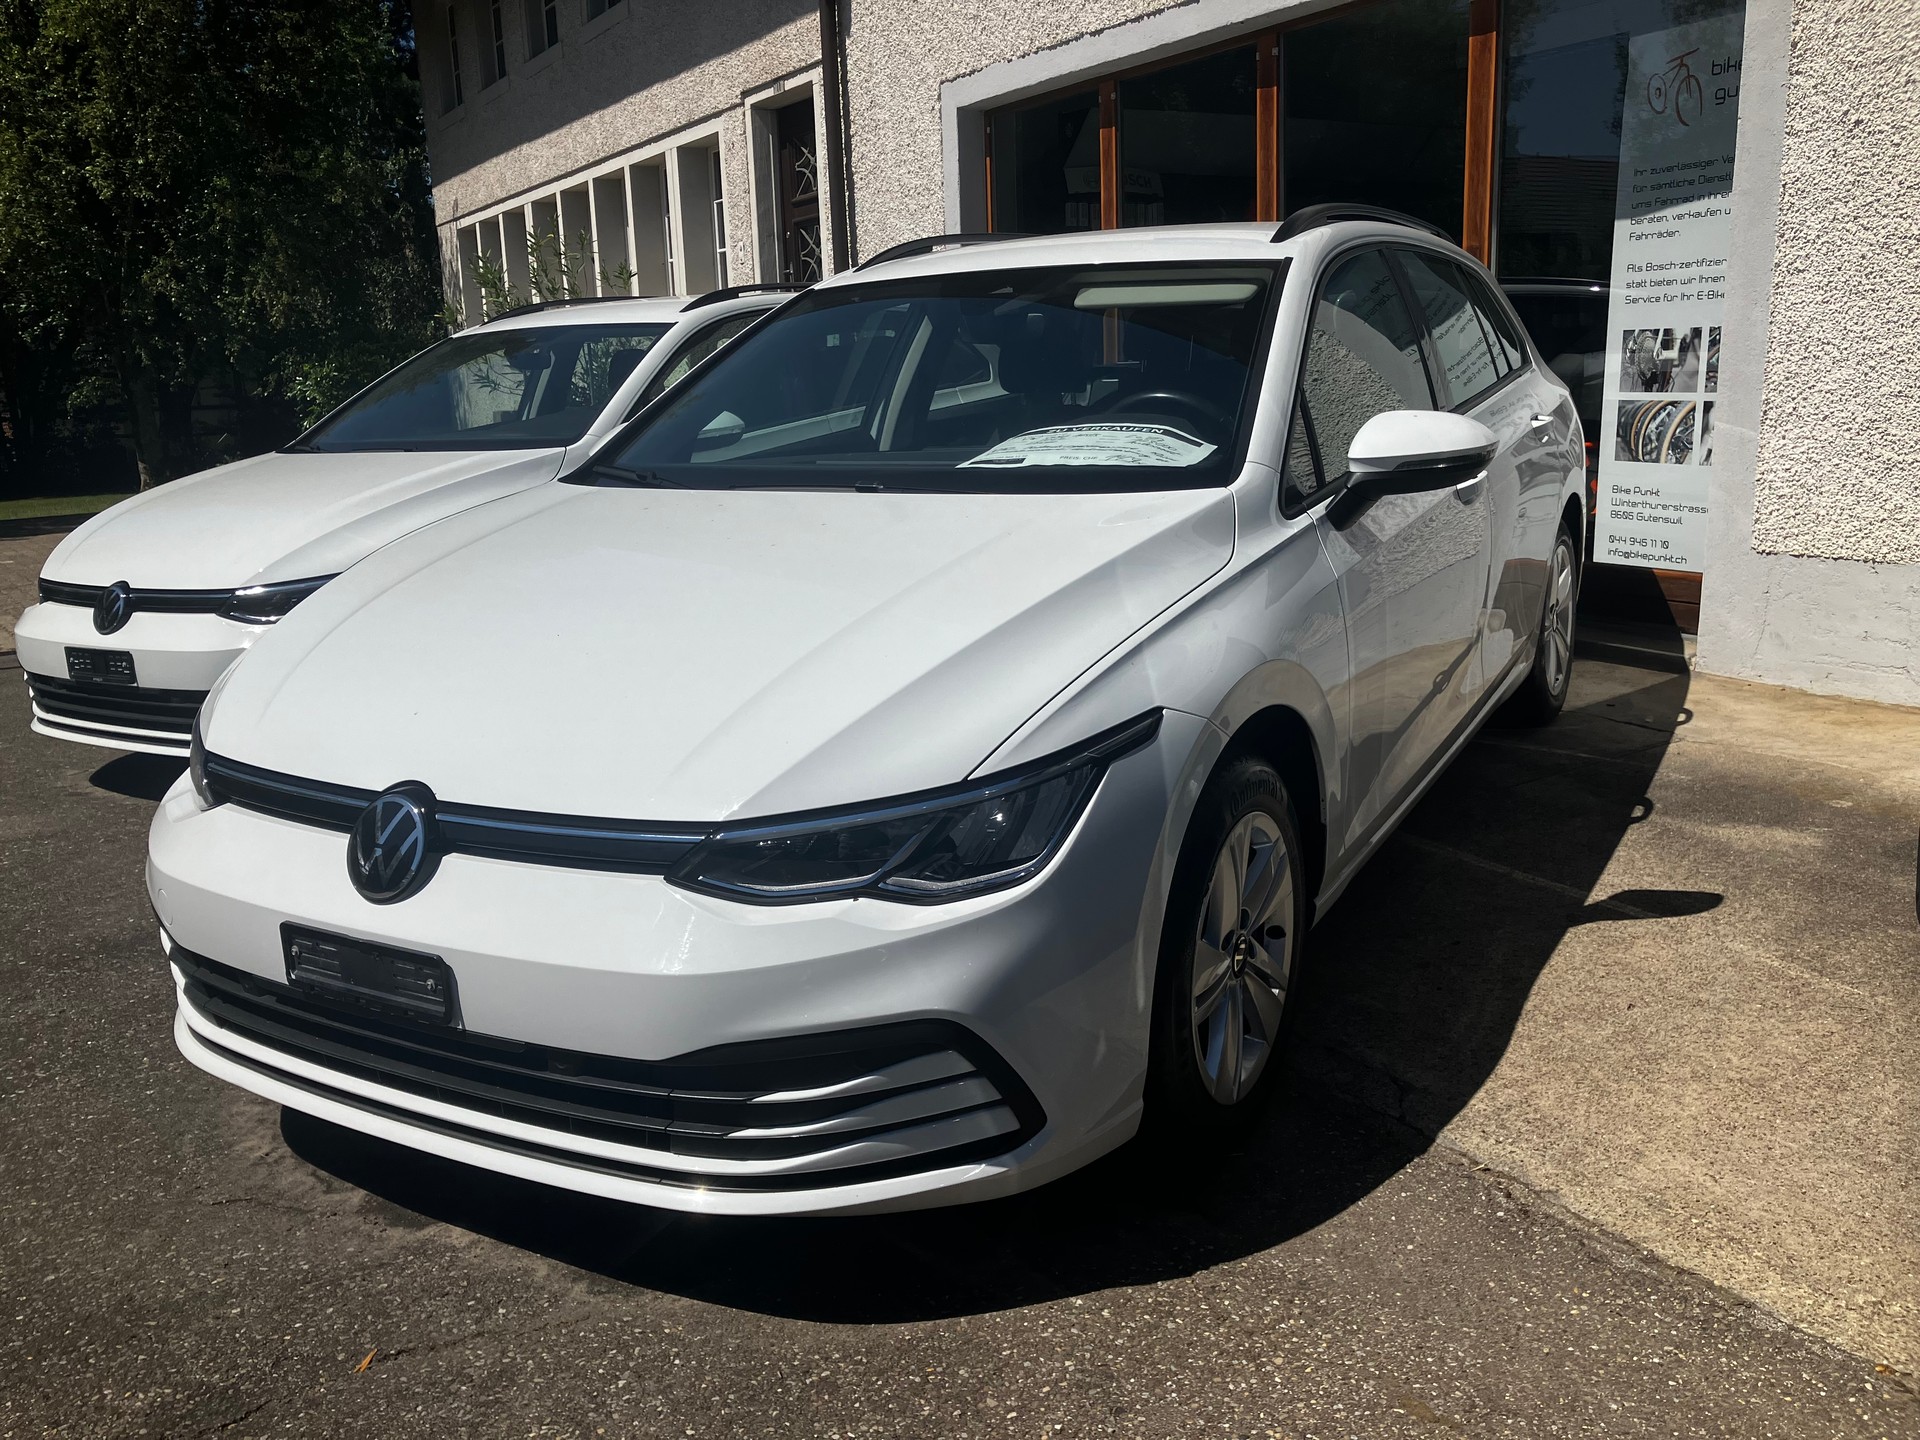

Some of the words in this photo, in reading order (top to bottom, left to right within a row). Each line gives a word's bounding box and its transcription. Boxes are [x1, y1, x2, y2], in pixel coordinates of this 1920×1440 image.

[1714, 85, 1739, 106] gu
[1631, 201, 1652, 210] ums
[1654, 194, 1695, 207] Fahrrad
[1696, 193, 1705, 202] in
[1671, 207, 1722, 221] verkaufen
[1626, 263, 1643, 273] Als
[1645, 257, 1728, 272] Bosch-zertifizier
[1625, 279, 1648, 289] statt
[1649, 278, 1678, 288] bieten
[1680, 276, 1697, 286] wir
[1698, 274, 1726, 284] Ihnen
[1624, 294, 1661, 305] Service
[1662, 293, 1678, 302] für
[1680, 292, 1695, 301] Ihr
[1696, 290, 1725, 300] E-Bik
[1072, 426, 1164, 434] VERKAUFEN
[1611, 484, 1632, 495] Bike
[1633, 486, 1660, 497] Punkt
[1610, 497, 1709, 514] Winterthurerstrass
[1610, 510, 1634, 521] 8605
[1636, 512, 1683, 525] Gutenswil
[1608, 534, 1627, 544] 044
[1629, 536, 1648, 548] 945
[1650, 539, 1658, 548] 11
[1659, 540, 1670, 550] 10
